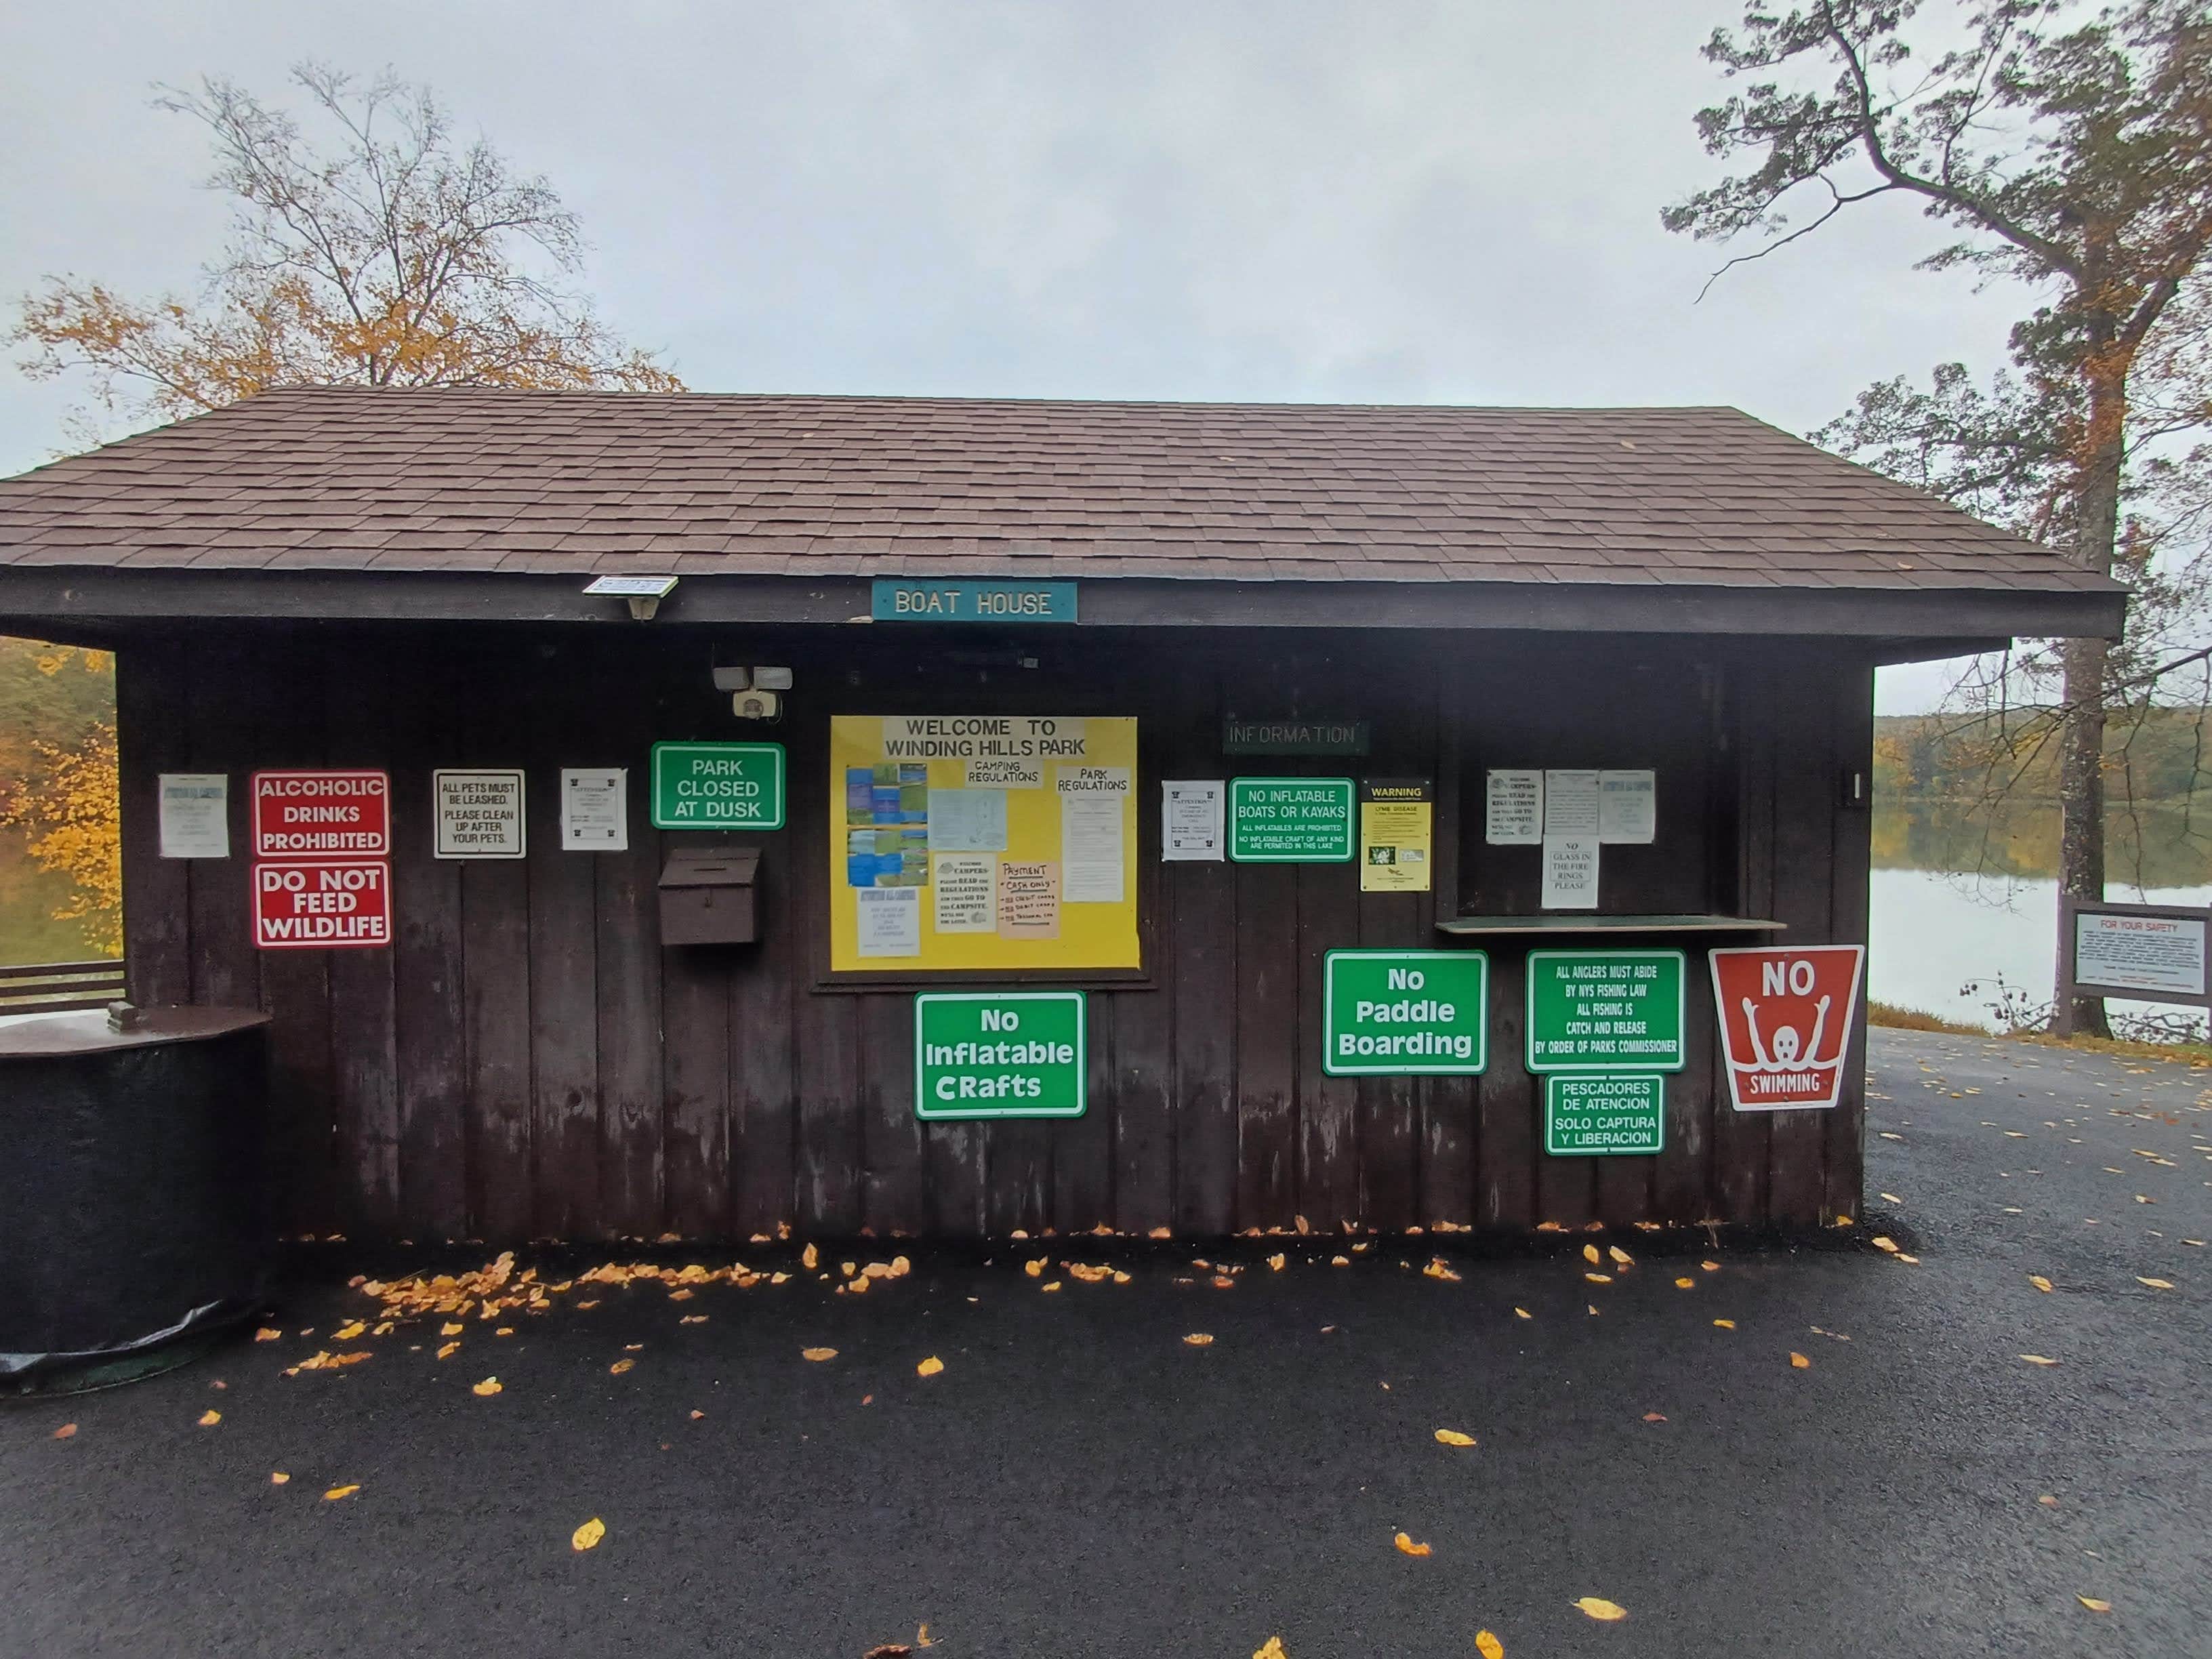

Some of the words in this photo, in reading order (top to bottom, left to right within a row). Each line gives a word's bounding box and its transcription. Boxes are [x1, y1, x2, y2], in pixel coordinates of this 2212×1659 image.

[895, 590, 960, 613] BOAT
[977, 592, 1052, 615] HOUSE
[907, 720, 1010, 735] WELCOME
[1027, 720, 1056, 735] TO
[1229, 726, 1355, 743] INFORMATION
[886, 740, 972, 756] WINDING
[980, 740, 1033, 756] HILLS
[1040, 739, 1086, 756] PARK
[692, 759, 743, 776] PARK
[975, 761, 1020, 772] CAMPING
[968, 772, 1039, 782] REGULATIONS
[1080, 769, 1107, 779] PARK
[260, 779, 384, 797] ALCOHOLIC
[442, 783, 459, 793] ALL
[462, 783, 487, 793] PETS
[489, 783, 515, 793] MUST
[677, 779, 760, 797] CLOSED
[1058, 780, 1127, 792] REGULATIONS
[1371, 787, 1421, 796] WARNING
[449, 795, 461, 804] BE
[1248, 790, 1266, 802] NO
[1271, 790, 1336, 802] INFLATABLE
[283, 806, 361, 823] DRINKS
[445, 811, 480, 820] PLEASE
[483, 810, 514, 820] CLEAN
[674, 801, 698, 817] AT
[706, 801, 762, 818] DUSK
[1238, 806, 1275, 818] BOATS
[1280, 806, 1297, 818] OR
[1302, 806, 1346, 818] KAYAKS
[455, 822, 468, 832] UP
[471, 822, 502, 832] AFTER
[263, 832, 382, 849] PROHIBITED
[452, 834, 478, 843] YOUR
[262, 870, 306, 892] DO
[319, 869, 380, 891] NOT
[293, 892, 357, 914] FEED
[262, 916, 384, 939] WILDLIFE
[2101, 920, 2116, 929] FOR
[2121, 921, 2142, 930] YOUR
[2146, 922, 2178, 933] SAFETY
[1388, 968, 1425, 990] No
[1556, 966, 1570, 979] ALL
[1572, 966, 1607, 979] ANGLERS
[1610, 966, 1632, 978] MUST
[1634, 965, 1657, 978] ABIDE
[1762, 960, 1815, 996] NO
[1565, 985, 1576, 998] BY
[1579, 985, 1594, 998] NYS
[1597, 984, 1626, 997] FISHING
[1630, 984, 1647, 996] LAW
[1357, 1000, 1455, 1023] Paddle
[1576, 1003, 1590, 1016] ALL
[1593, 1003, 1623, 1016] FISHING
[1626, 1003, 1633, 1015] IS
[981, 1009, 1019, 1031] No
[1566, 1022, 1591, 1035] CATCH
[1594, 1021, 1610, 1034] AND
[1614, 1021, 1646, 1034] RELEASE
[1339, 1031, 1471, 1059] Boarding
[1535, 1041, 1544, 1054] BY
[1549, 1041, 1574, 1053] ORDER
[1577, 1041, 1588, 1053] OF
[1591, 1040, 1616, 1053] PARKS
[1618, 1040, 1677, 1052] COMMISSIONER
[926, 1041, 1073, 1065] Inflatable
[935, 1074, 1041, 1100] CRafts
[1562, 1082, 1650, 1095] PESCADORES
[1750, 1073, 1820, 1094] SWIMMING
[1563, 1099, 1580, 1111] DE
[1586, 1097, 1650, 1110] ATENCION
[1555, 1118, 1591, 1130] SOLO
[1597, 1117, 1656, 1129] CAPTURA
[1561, 1133, 1570, 1145] Y
[1575, 1132, 1651, 1144] LIBERACION
